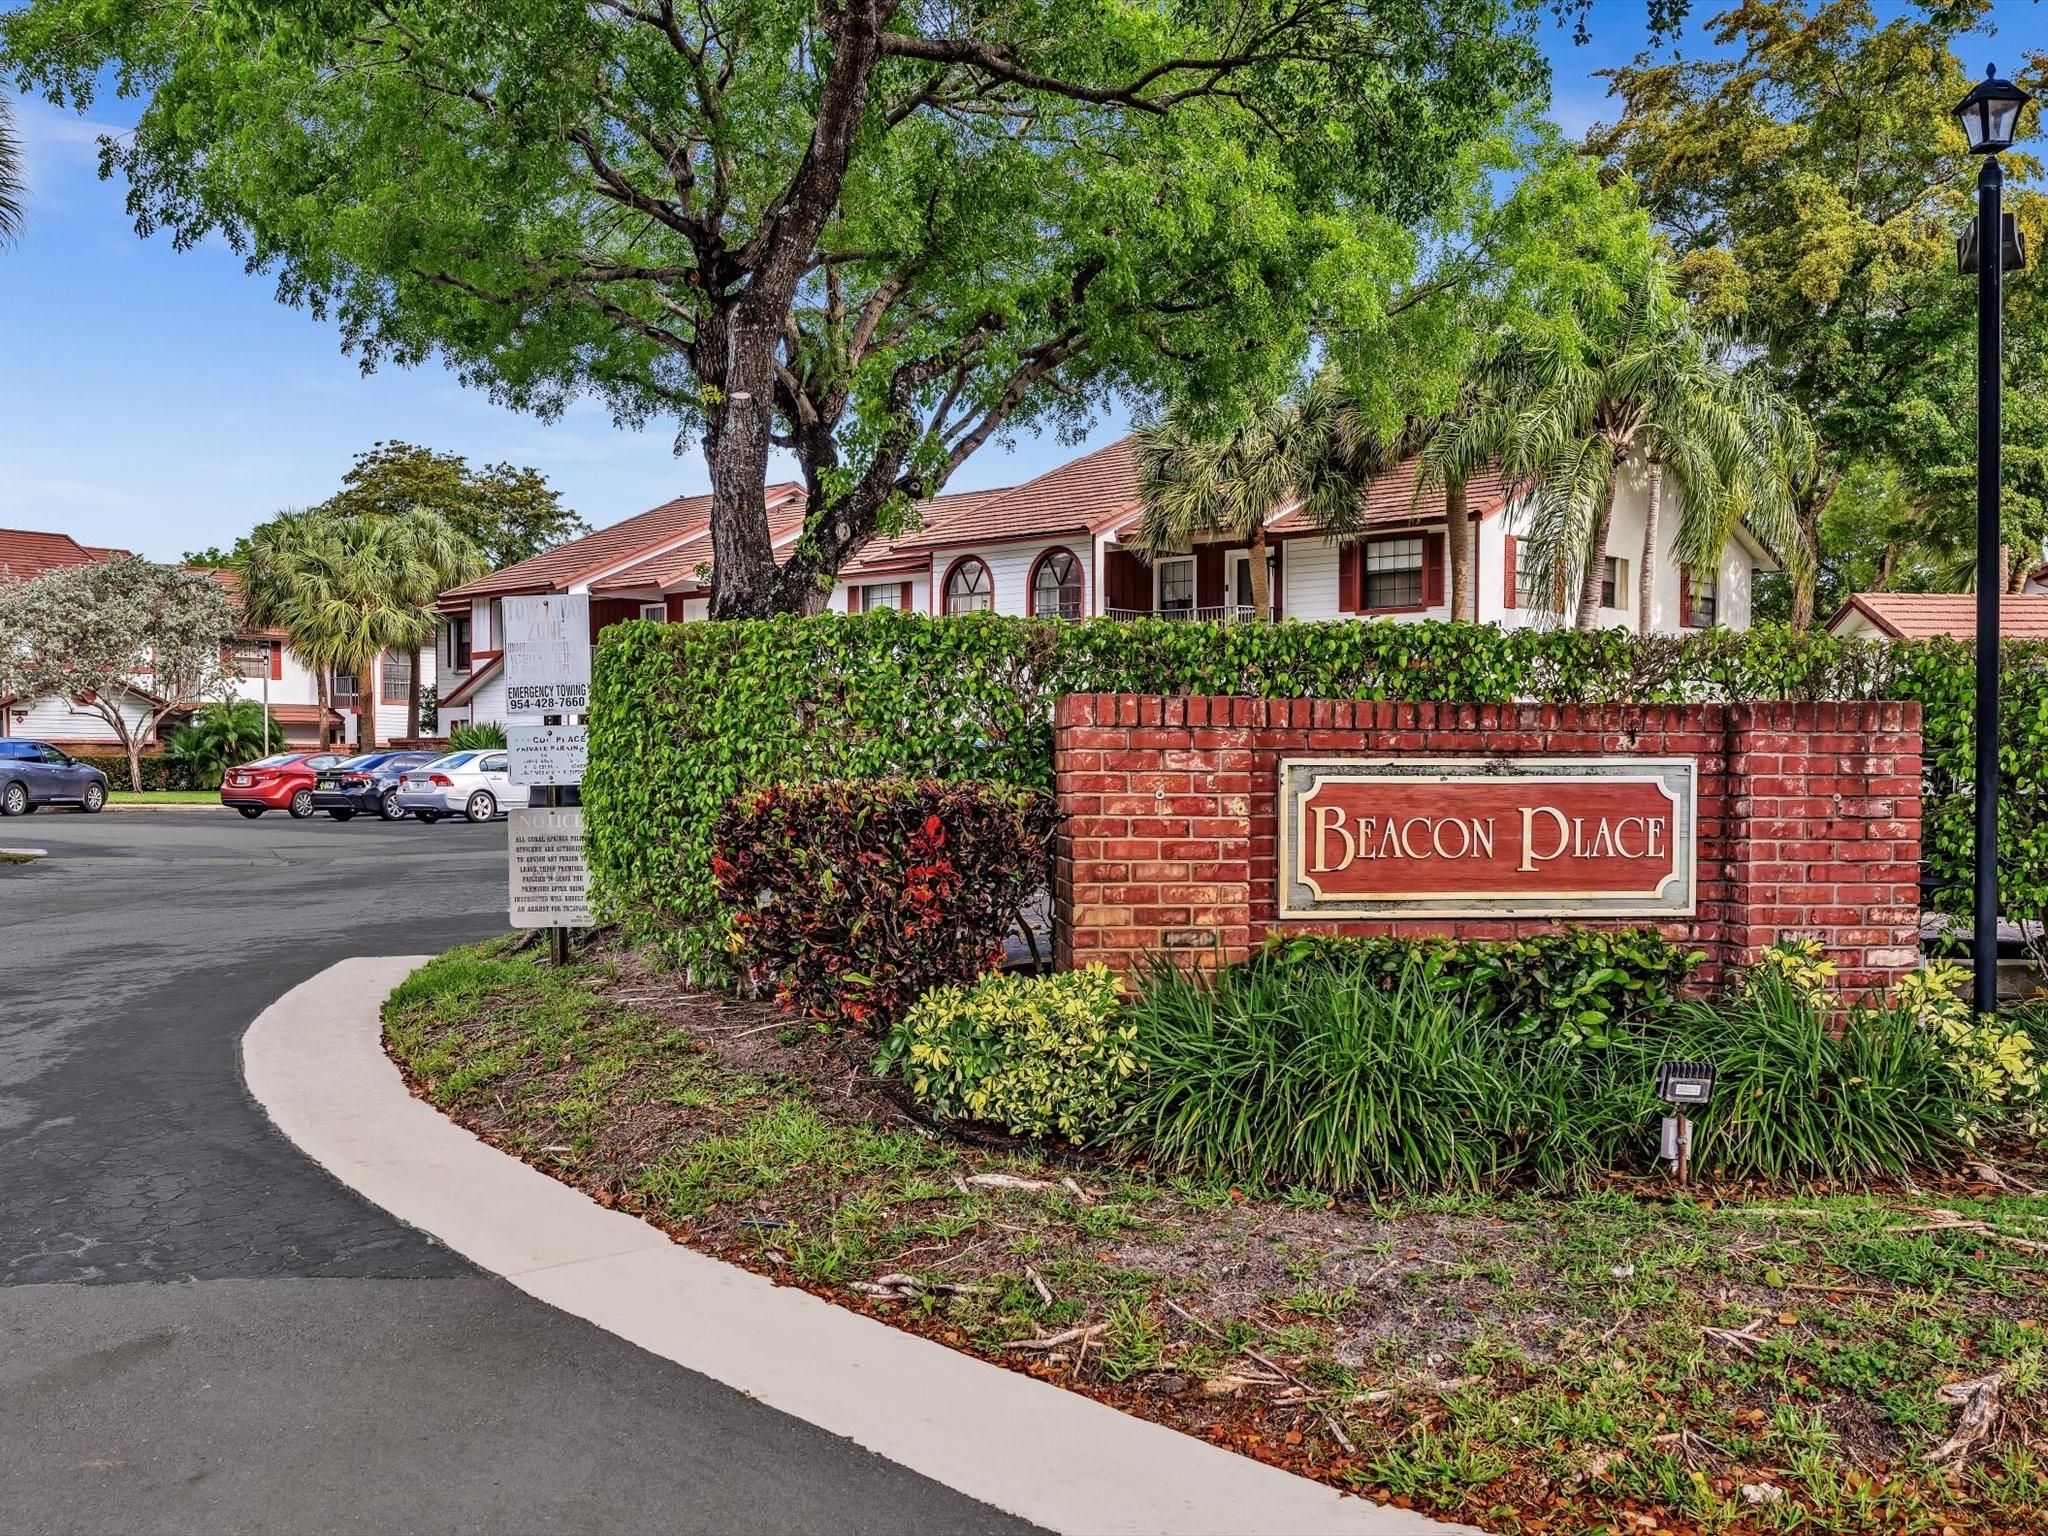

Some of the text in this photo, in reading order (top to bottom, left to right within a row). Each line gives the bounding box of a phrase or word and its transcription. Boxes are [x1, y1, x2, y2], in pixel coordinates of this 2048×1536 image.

[507, 683, 587, 699] EMERGENCY TOWING
[510, 697, 586, 710] 954-428-7660
[1309, 806, 1666, 873] BEACON PLACE
